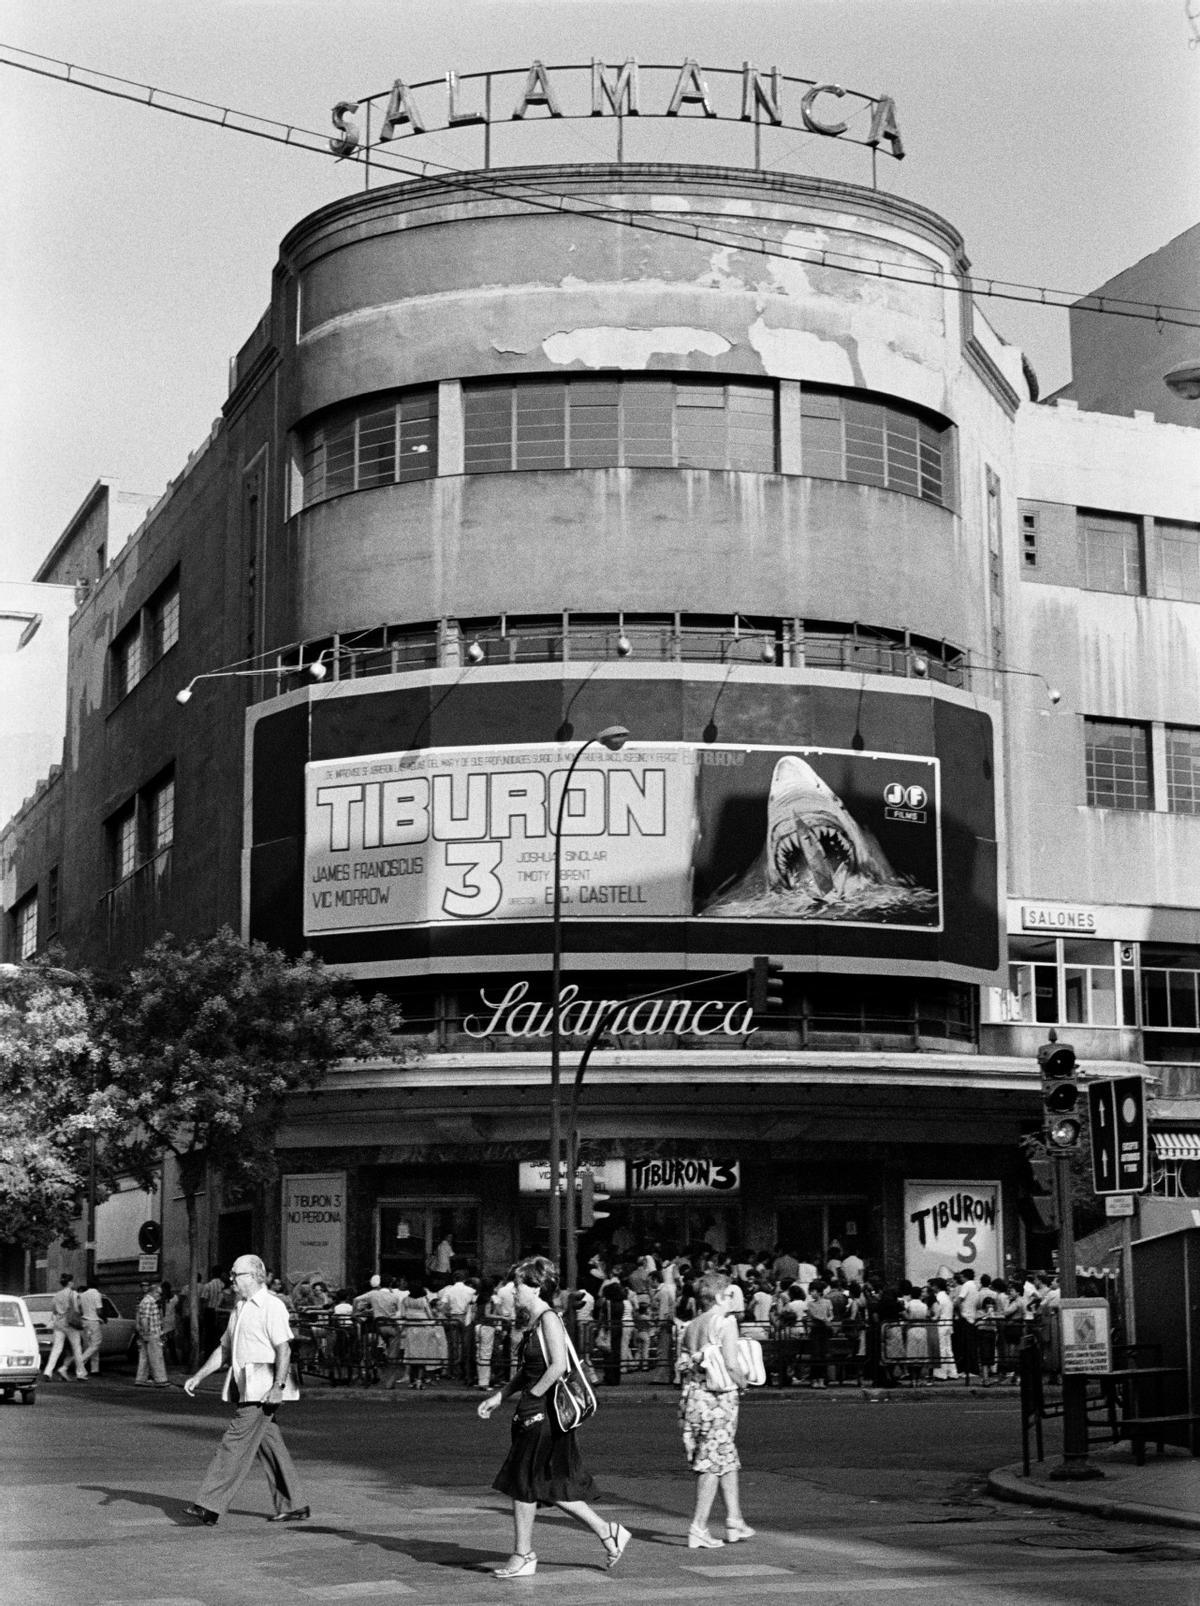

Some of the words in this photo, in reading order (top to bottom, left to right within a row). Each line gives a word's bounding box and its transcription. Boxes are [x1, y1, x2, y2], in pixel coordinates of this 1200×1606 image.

[330, 57, 905, 160] SALAMANCA
[317, 769, 666, 852] TIBURON
[893, 810, 918, 821] FILMS
[313, 863, 350, 883] JAMES
[442, 840, 503, 918] 3
[312, 891, 332, 908] VIC
[335, 886, 391, 907] MORROW
[579, 885, 648, 904] CASTELL
[1028, 910, 1095, 928] SALONES
[463, 980, 760, 1038] Salamanca
[631, 1159, 714, 1191] TIBURON
[711, 1158, 740, 1190] 3
[288, 1211, 301, 1224] NO
[302, 1211, 342, 1224] PERDONA
[910, 1192, 997, 1249] TIBURON
[956, 1227, 978, 1264] 3
